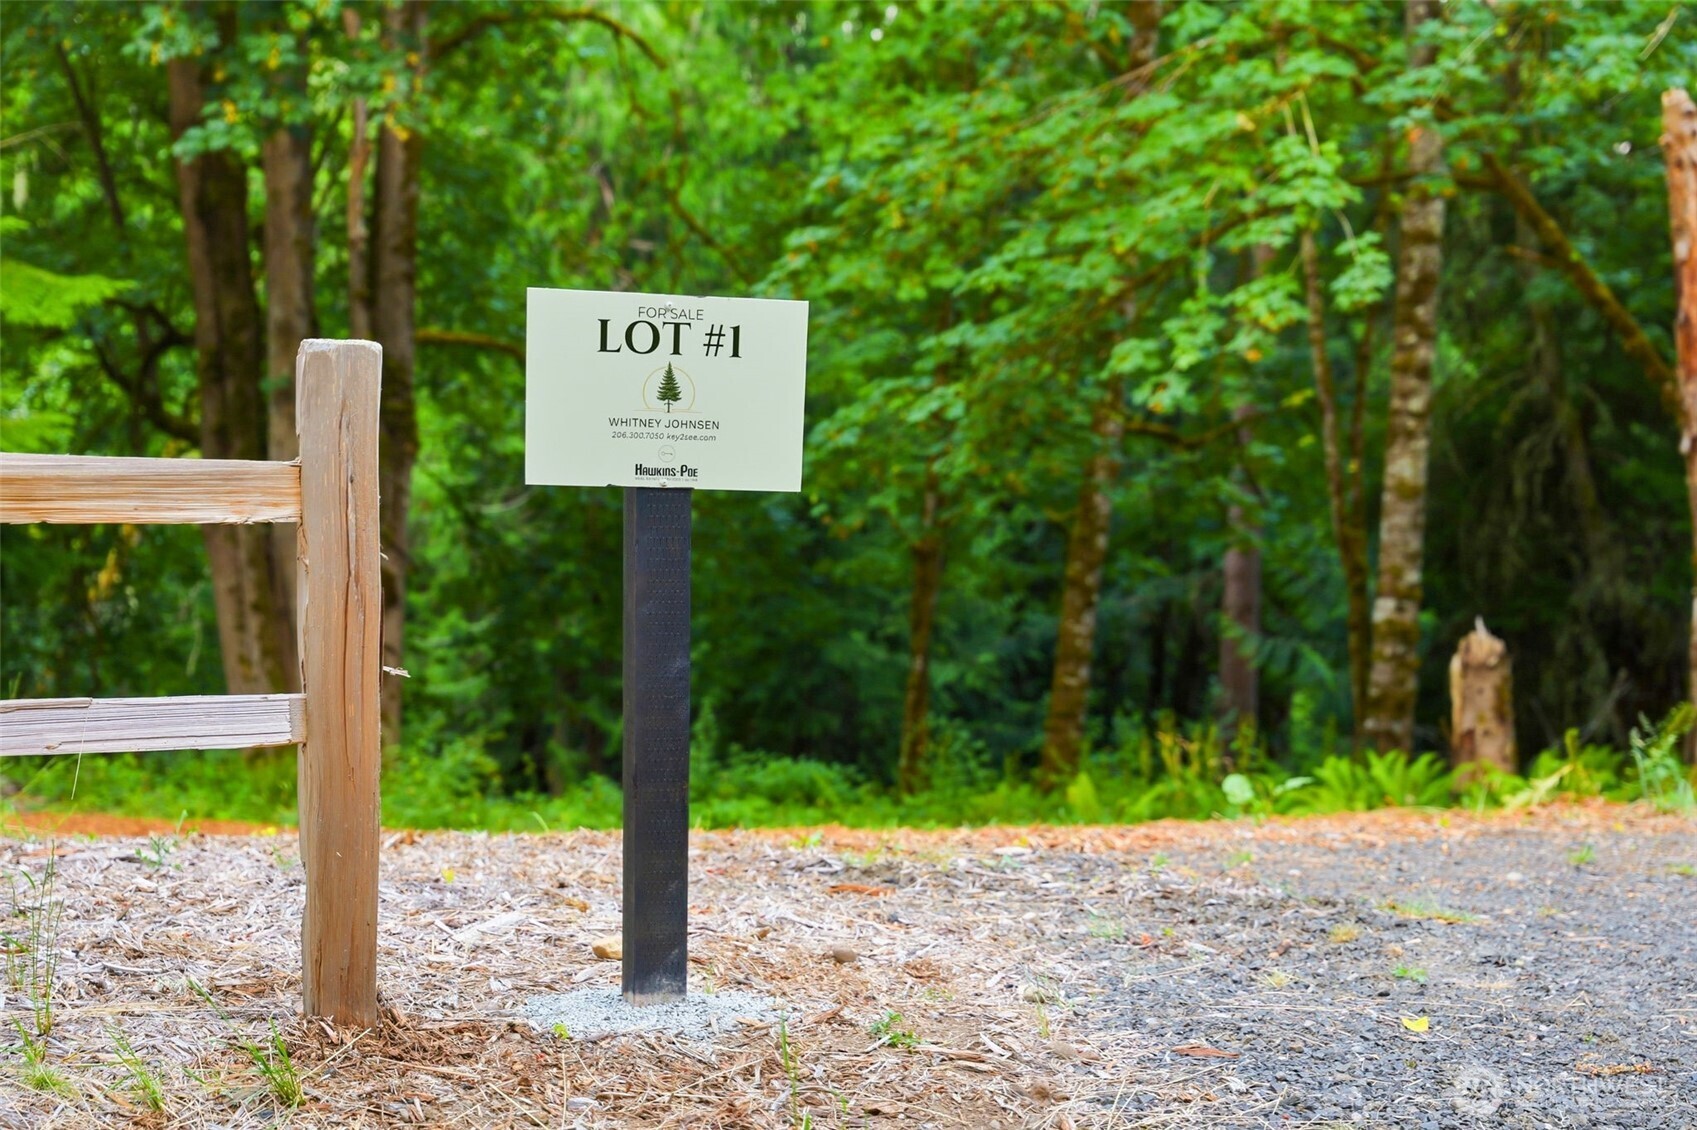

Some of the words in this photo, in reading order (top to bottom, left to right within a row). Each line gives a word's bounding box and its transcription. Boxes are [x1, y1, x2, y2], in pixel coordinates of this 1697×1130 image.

[638, 306, 667, 319] FOR
[669, 307, 704, 320] SALE
[596, 318, 692, 356] LOT
[702, 324, 742, 358] #1
[608, 417, 662, 428] WHITNEY
[664, 419, 720, 430] JOHNSEN
[611, 431, 665, 440] 206.300.7050
[666, 432, 717, 442] key2see.com
